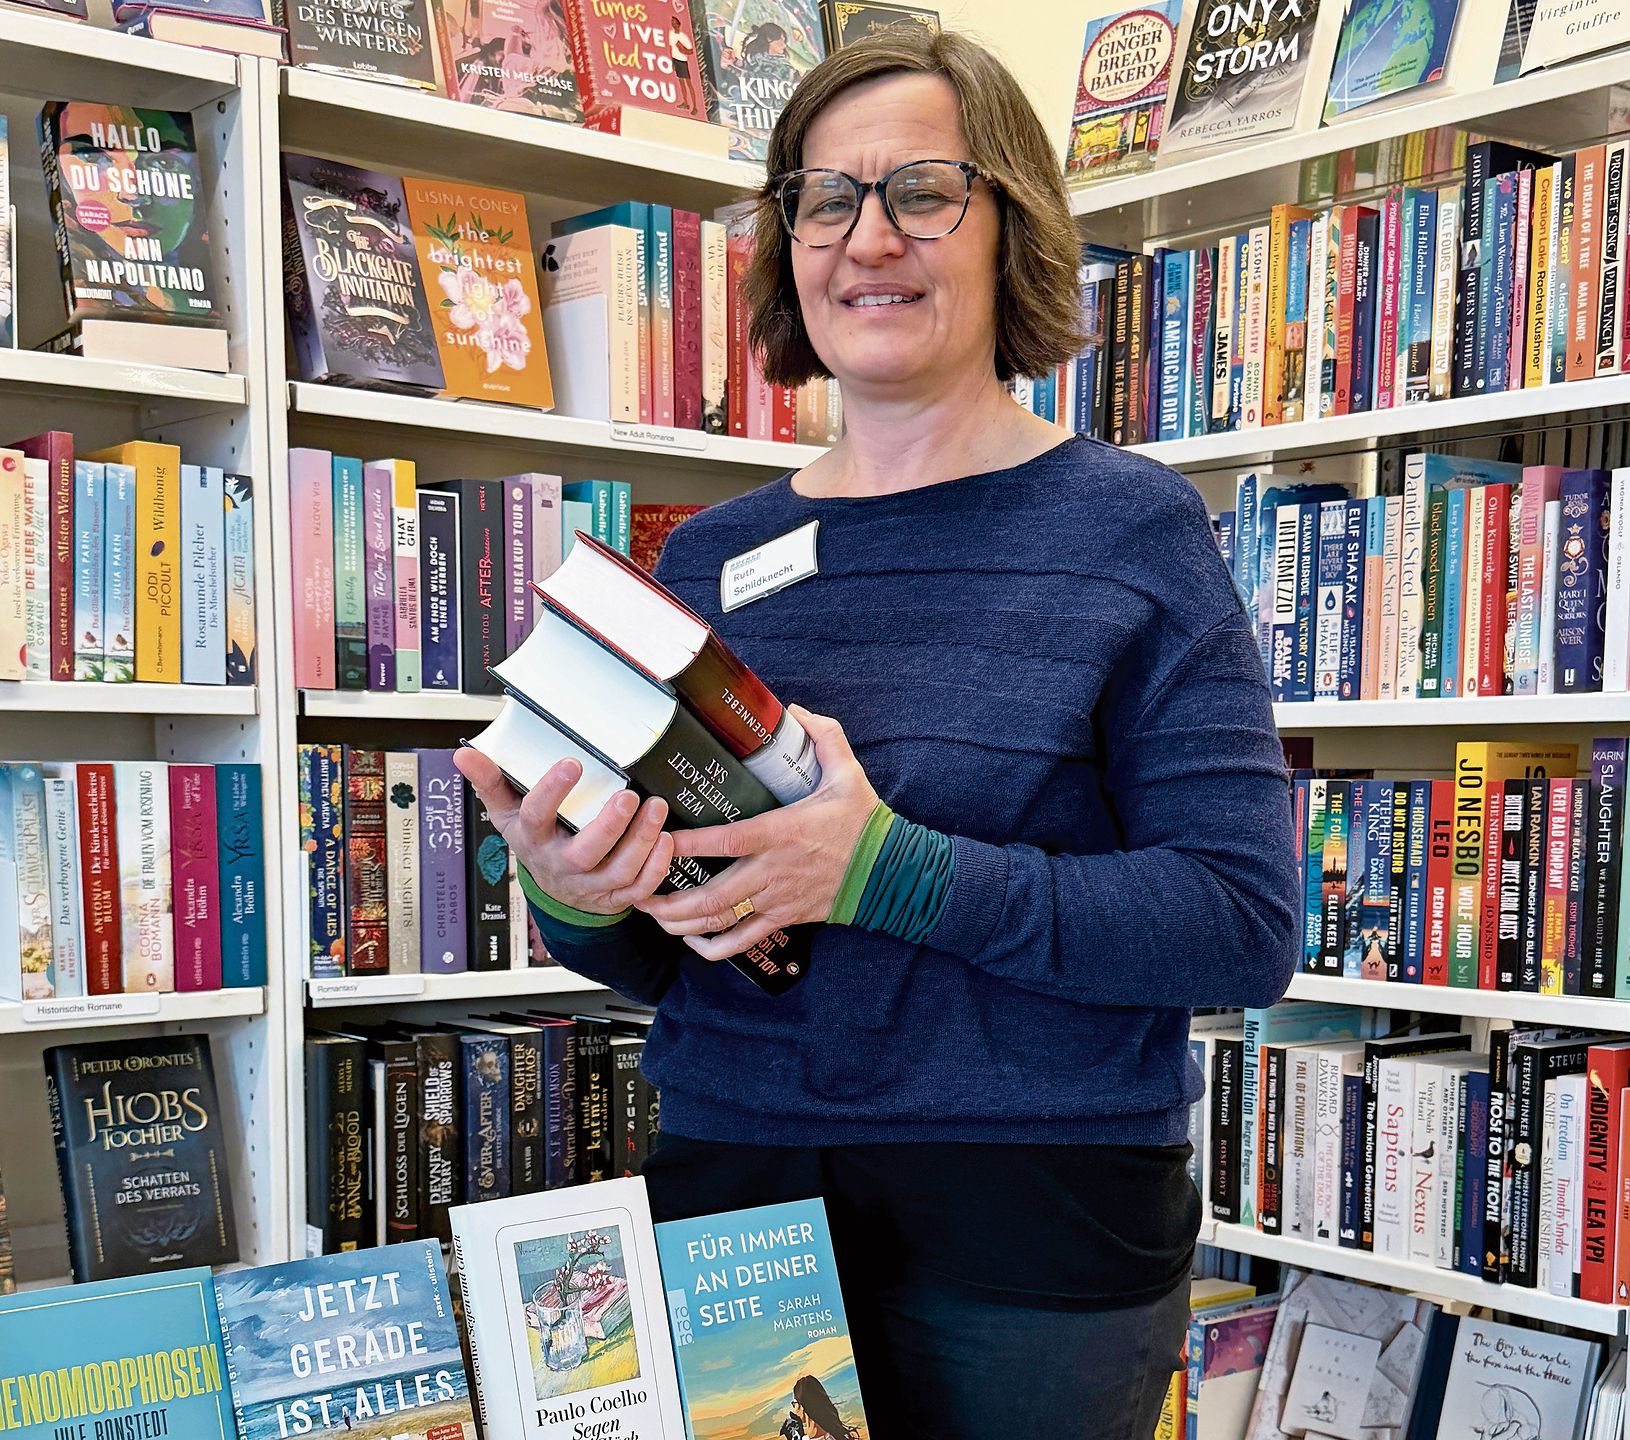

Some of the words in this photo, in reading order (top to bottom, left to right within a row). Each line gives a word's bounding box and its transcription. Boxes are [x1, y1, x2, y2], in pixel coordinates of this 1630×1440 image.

[298, 6, 336, 25] DES
[343, 12, 422, 42] EWIGEN
[357, 0, 405, 20] WEG
[1207, 0, 1303, 37] ONYX
[1565, 11, 1621, 36] Giuffre
[315, 26, 408, 55] WINTERS
[622, 21, 665, 46] I'VE
[1097, 29, 1163, 59] GINGER
[1119, 22, 1145, 37] The
[602, 41, 642, 69] lied
[644, 51, 674, 75] TO
[1098, 46, 1157, 75] BREAD
[1193, 33, 1300, 83] STORM
[621, 75, 677, 104] YOU
[1090, 61, 1161, 93] BAKERY
[91, 122, 161, 153] HALLO
[1180, 119, 1233, 139] REBECCA
[1236, 108, 1283, 127] YARROS
[70, 165, 99, 191] DU
[107, 167, 194, 200] SCHÖNE
[1472, 153, 1482, 187] JOHN
[1609, 155, 1621, 216] PROPHET
[415, 190, 464, 206] LISINA
[469, 196, 519, 216] CONEY
[1470, 191, 1481, 236] IRVING
[1539, 179, 1550, 230] Creation
[124, 236, 163, 262] ANN
[458, 223, 489, 242] the
[1606, 218, 1617, 255] SONG
[312, 238, 417, 287] BLACKGATE
[428, 244, 522, 273] brightest
[1537, 232, 1546, 269] Lake
[86, 259, 205, 292] NAPOLITANO
[339, 276, 415, 307] INVITATION
[1536, 270, 1546, 314] Rachel
[1603, 270, 1615, 303] PAUL
[1466, 272, 1476, 316] QUEEN
[446, 331, 531, 353] sunshine
[1602, 305, 1614, 346] LYNCH
[1163, 320, 1181, 389] AMERICAN
[1215, 332, 1228, 380] JAMES
[1464, 320, 1474, 369] ESTHER
[1532, 318, 1543, 370] Kushner
[1161, 393, 1178, 432] DIRT
[613, 428, 627, 438] New
[628, 430, 645, 440] Adult
[647, 432, 675, 442] Romance
[152, 467, 168, 531] Wildhonig
[1406, 462, 1423, 545] Danielle
[397, 516, 405, 546] THAT
[407, 519, 415, 546] GIRL
[512, 504, 524, 537] TOUR
[1349, 508, 1360, 538] ELIF
[193, 523, 206, 567] Pilcher
[429, 537, 438, 567] DOCH
[430, 569, 438, 594] WILL
[438, 552, 448, 598] STERBEN
[512, 539, 525, 594] BREAKUP
[734, 567, 755, 583] Ruth
[734, 563, 794, 597] Schildknecht
[1276, 520, 1296, 614] INTERMEZZO
[1345, 542, 1359, 604] SHAFAK
[1402, 550, 1419, 597] Steel
[147, 571, 158, 604] JODI
[160, 562, 171, 617] PICOULT
[194, 569, 207, 649] Rosamunde
[431, 596, 439, 623] ENDE
[439, 600, 448, 629] EINER
[513, 599, 525, 622] THE
[431, 626, 439, 644] AM
[1274, 630, 1285, 687] ROONEY
[1284, 636, 1293, 681] SALLY
[721, 688, 777, 748] LÜGENNEBEL
[705, 758, 729, 784] SÄT
[1592, 751, 1624, 761] KARIN
[668, 752, 741, 823] ZWIETRACHT
[793, 765, 813, 788] Viveca
[1459, 758, 1484, 789] JO
[676, 786, 705, 817] WER
[1597, 764, 1613, 863] SLAUGHTER
[1368, 802, 1380, 841] KING
[1379, 789, 1392, 856] STEPHEN
[1433, 820, 1450, 859] LEO
[325, 852, 336, 884] DANCE
[233, 875, 243, 924] Alexandra
[244, 880, 255, 915] Bröhm
[327, 887, 337, 905] OF
[485, 903, 501, 912] Kate
[1432, 887, 1445, 918] DEON
[1456, 885, 1474, 922] WOLF
[326, 910, 337, 937] LIES
[481, 911, 506, 920] Dramis
[1430, 921, 1443, 957] MEYER
[1456, 925, 1472, 959] HOUR
[317, 983, 358, 993] Romantasy
[37, 1004, 84, 1016] Historische
[87, 1002, 123, 1013] Romane
[1244, 1020, 1259, 1058] Moral
[82, 1060, 122, 1074] PETER
[124, 1054, 194, 1072] ORONTES
[430, 1067, 438, 1077] OF
[1522, 1054, 1532, 1093] STEVEN
[425, 1077, 439, 1120] SHIELD
[439, 1061, 452, 1125] SPARROWS
[1243, 1062, 1258, 1116] Ambition
[1318, 1058, 1328, 1119] DAWKINS
[1329, 1065, 1339, 1114] RICHARD
[84, 1081, 208, 1143] HIOBS
[1367, 1101, 1376, 1121] The
[1519, 1095, 1531, 1138] PINKER
[99, 1123, 185, 1150] TOCHTER
[1366, 1122, 1376, 1163] Anxious
[1588, 1086, 1610, 1173] INDIGNITY
[1384, 1104, 1405, 1193] Sapiens
[122, 1171, 190, 1190] SCHATTEN
[429, 1145, 442, 1205] DEVNEY
[441, 1159, 452, 1204] PERRY
[116, 1191, 142, 1206] DES
[146, 1183, 200, 1200] VERRATS
[1364, 1165, 1374, 1223] Generation
[1414, 1170, 1433, 1234] Nexus
[1587, 1200, 1606, 1229] LEA
[687, 1231, 734, 1263] FÜR
[740, 1222, 814, 1253] IMMER
[1586, 1233, 1605, 1264] YPI
[426, 1249, 439, 1285] ullstein
[695, 1270, 729, 1294] AN
[736, 1254, 818, 1288] DEINER
[299, 1272, 400, 1322] JETZT
[433, 1294, 445, 1318] park
[699, 1295, 763, 1329] SEITE
[778, 1294, 821, 1313] SARAH
[773, 1310, 833, 1333] MARTENS
[808, 1326, 837, 1339] ROMAN
[290, 1322, 427, 1379] GERADE
[1473, 1333, 1491, 1346] The
[1465, 1351, 1480, 1363] the
[1525, 1364, 1540, 1377] the
[276, 1395, 333, 1439] IST
[354, 1370, 456, 1420] ALLES
[536, 1405, 585, 1427] Paulo
[590, 1390, 647, 1413] Coelho
[572, 1418, 621, 1440] Segen
